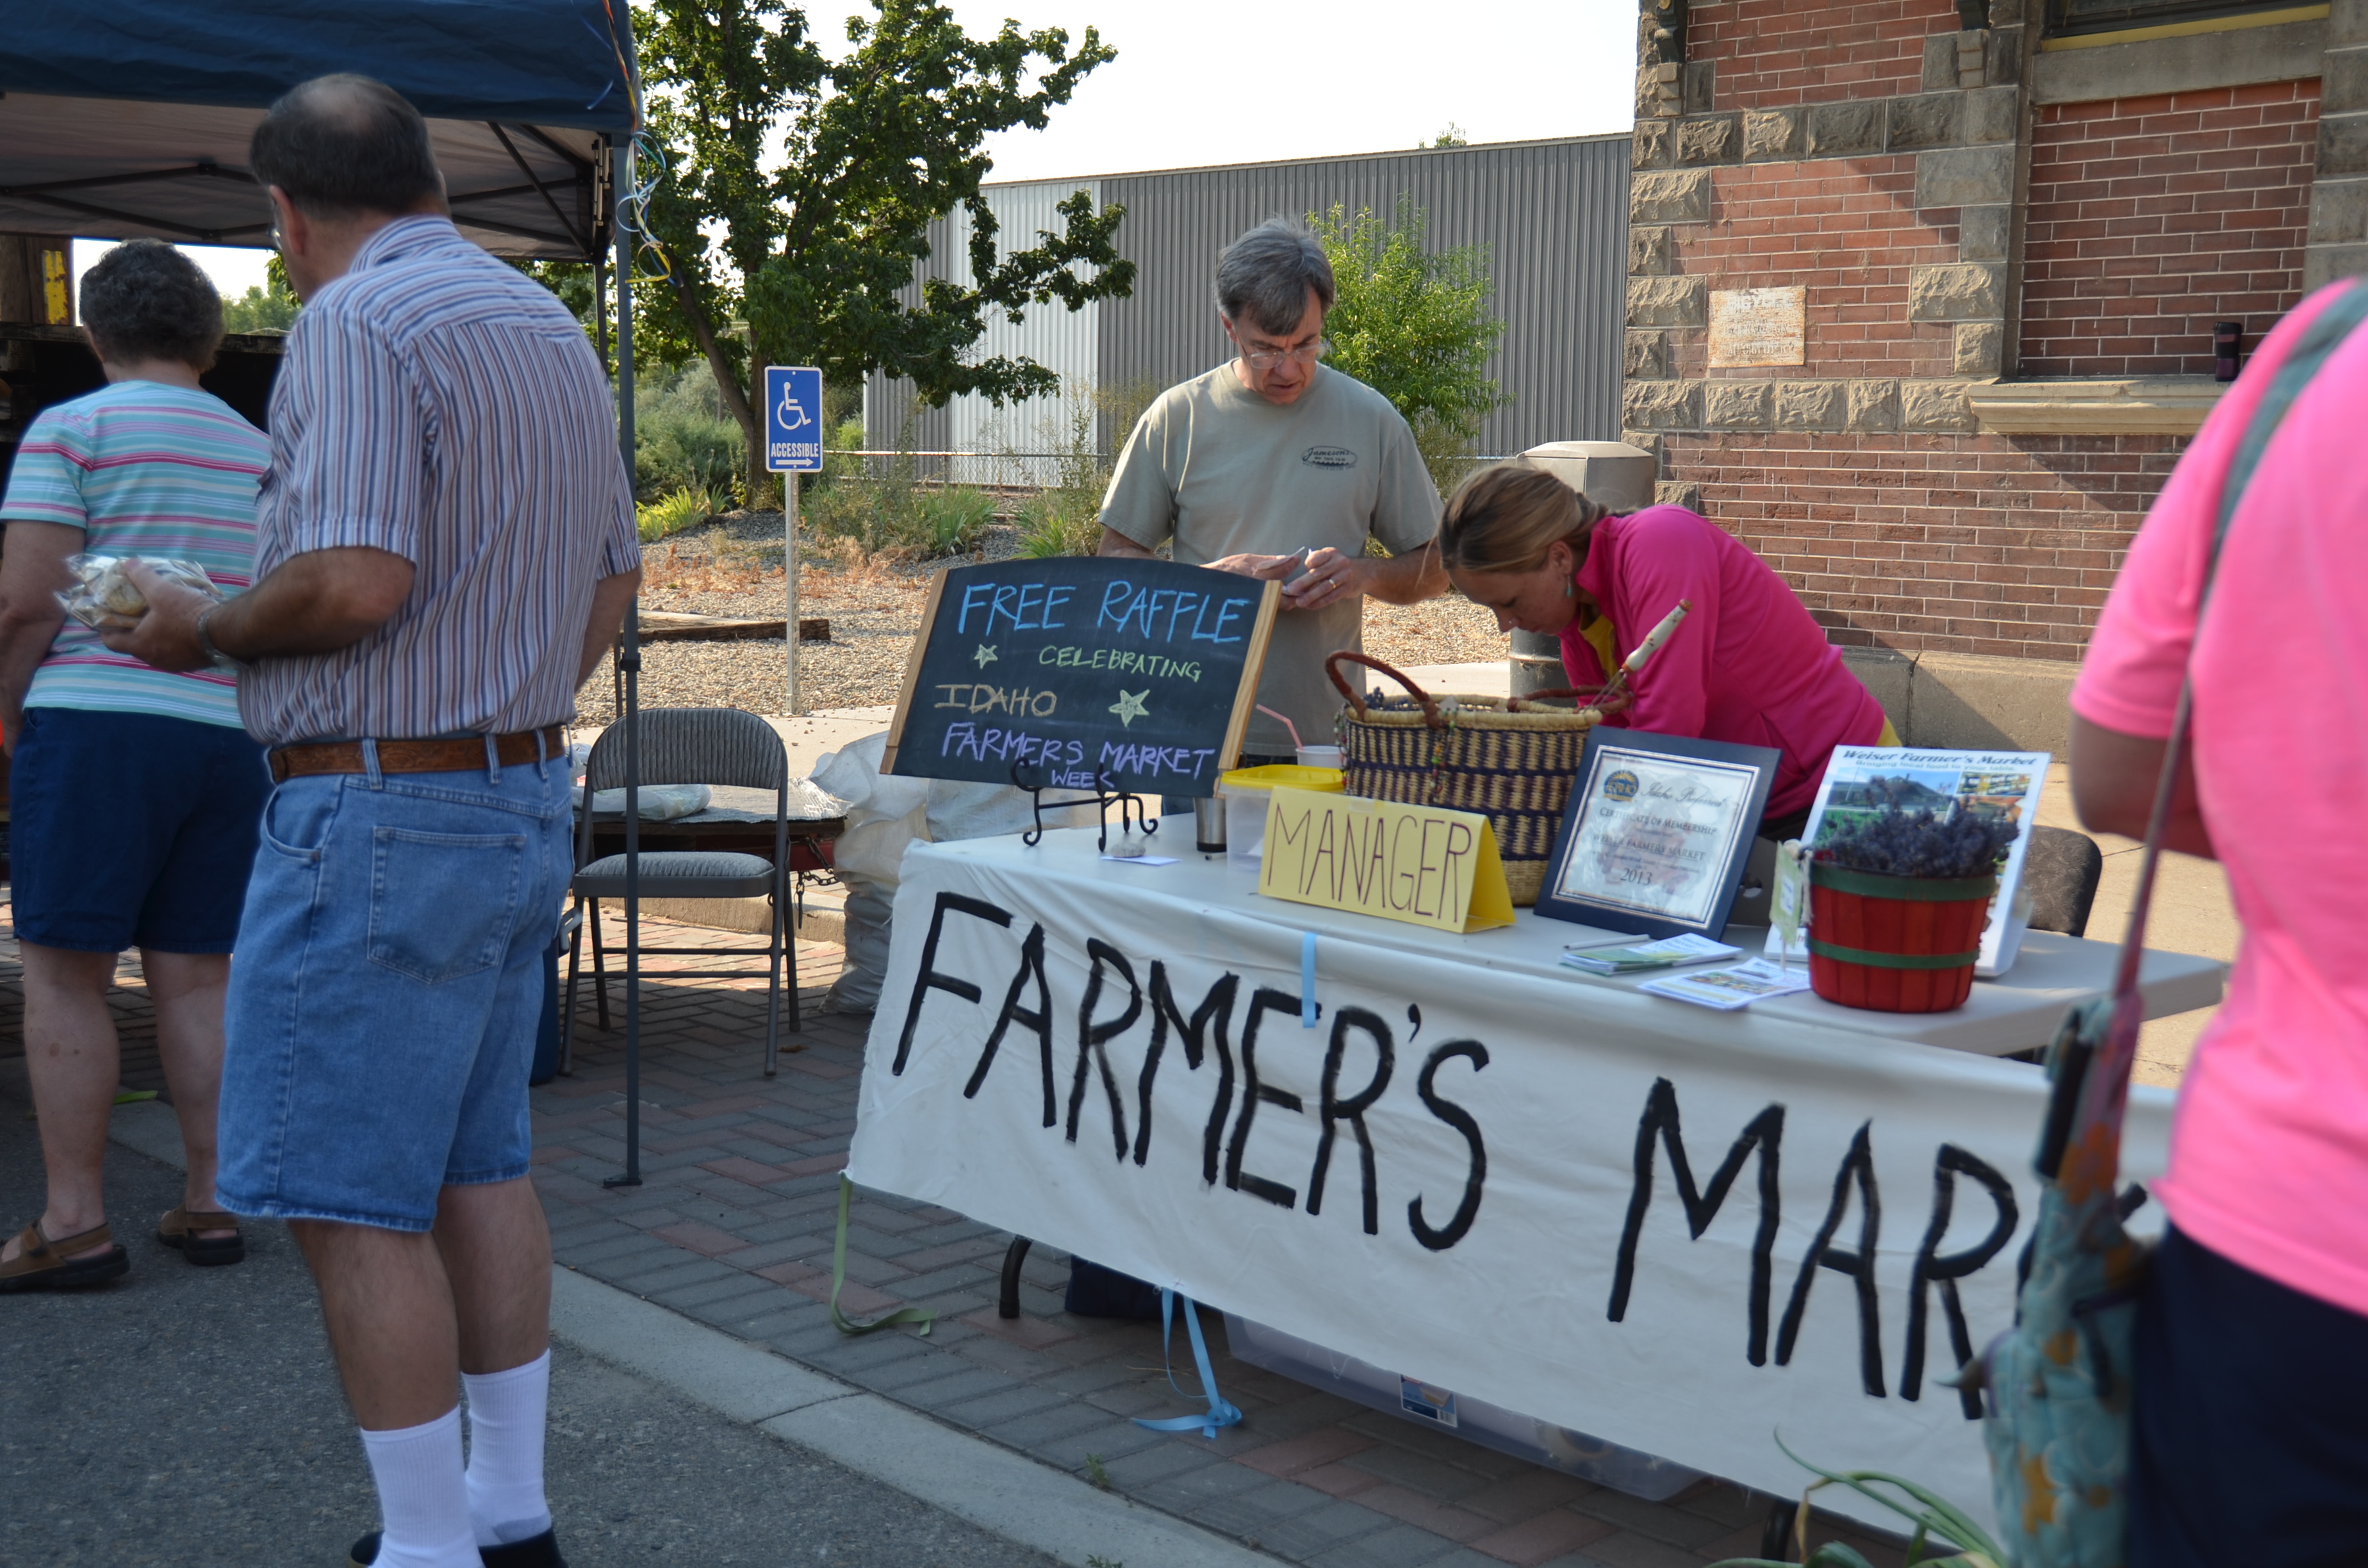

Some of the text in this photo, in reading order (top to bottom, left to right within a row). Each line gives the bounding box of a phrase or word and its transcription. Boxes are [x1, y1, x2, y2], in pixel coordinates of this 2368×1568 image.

[771, 442, 819, 457] ACCESSIBLE
[958, 580, 1253, 642] FREE RAFFLE
[1039, 646, 1202, 682] CELEBRATING
[934, 683, 1057, 717] IDAHO
[942, 721, 1215, 779] FARMERS MARKET
[1843, 750, 2037, 765] Weiser Farmer's Market
[1855, 760, 1897, 769] Bringing
[1268, 803, 1472, 923] MANAGER
[1668, 847, 1705, 860] MARKET
[1620, 867, 1652, 885] 2013
[892, 892, 1490, 1252] FARMER'S
